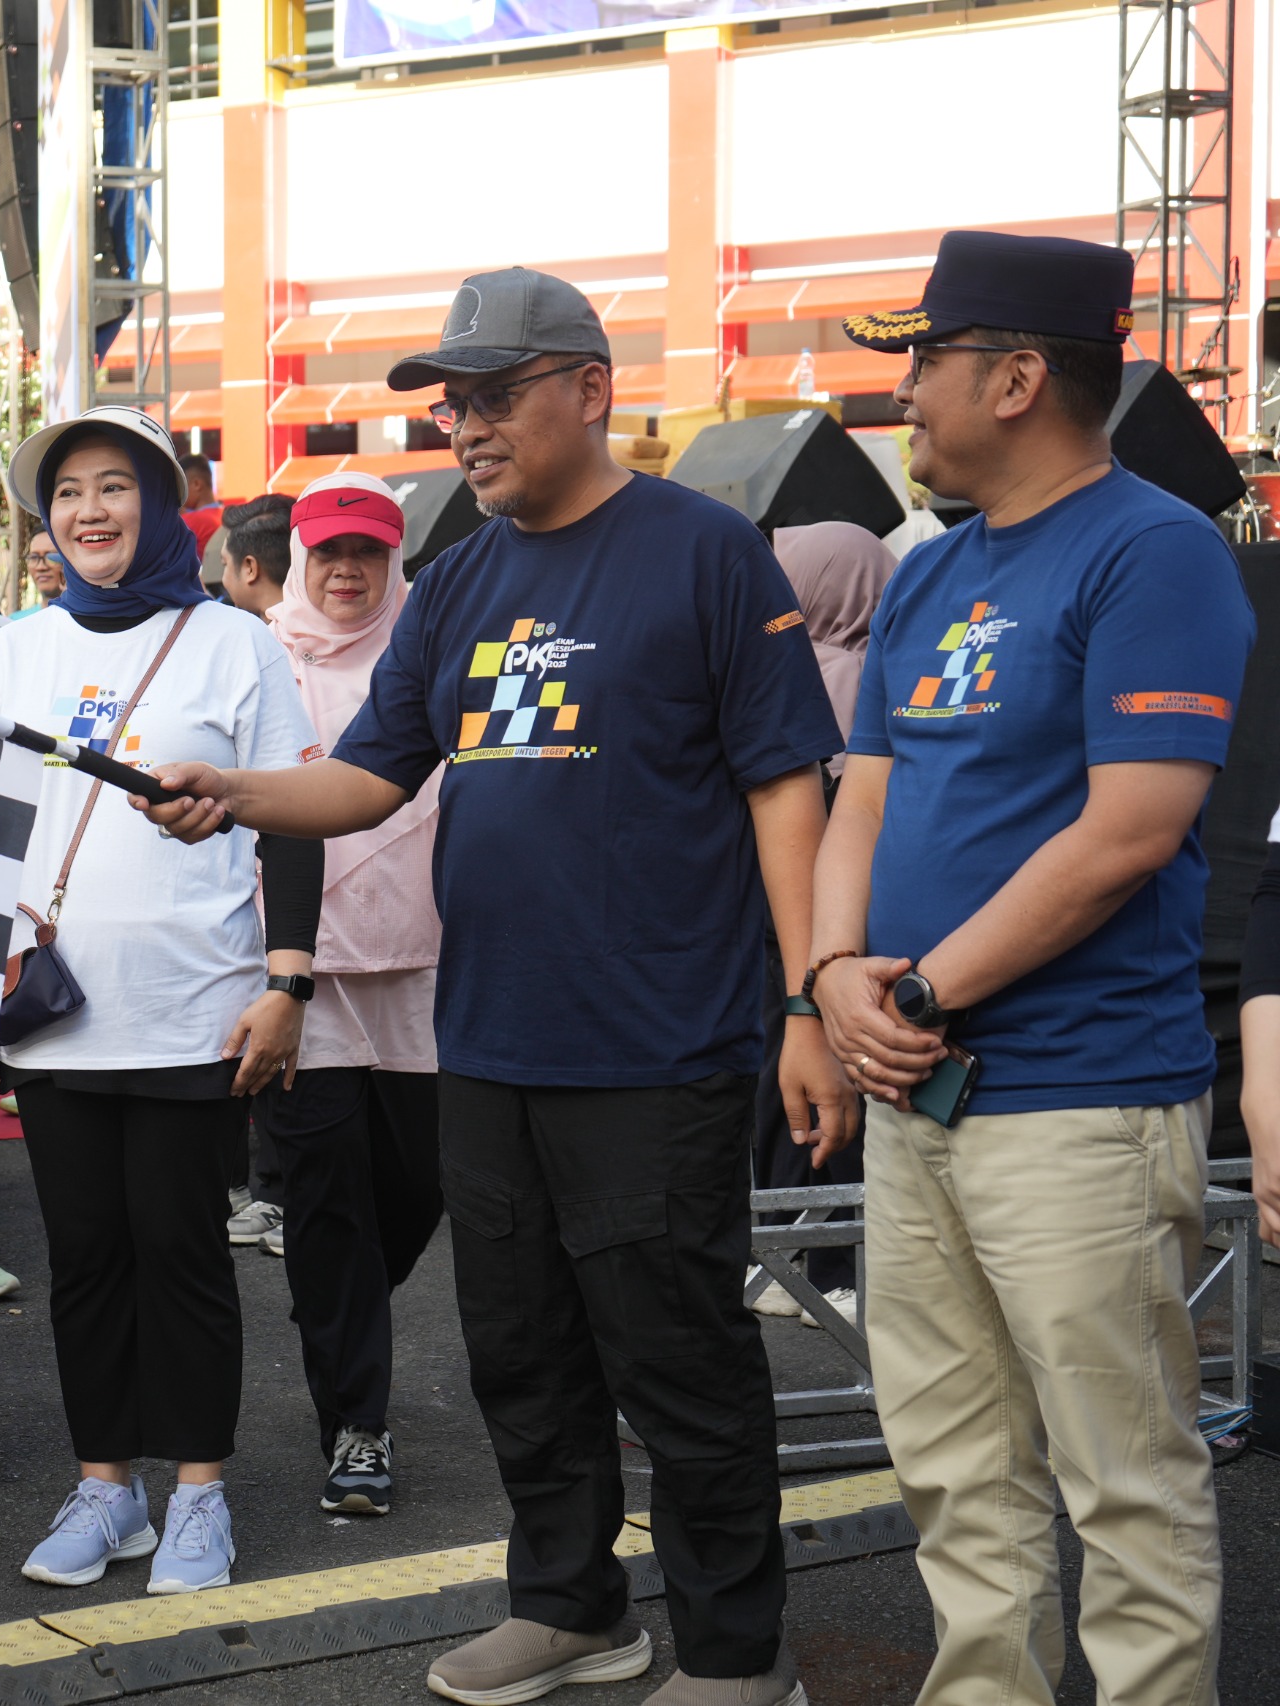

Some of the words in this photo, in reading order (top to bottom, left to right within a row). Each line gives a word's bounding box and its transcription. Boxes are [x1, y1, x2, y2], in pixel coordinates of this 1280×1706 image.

[548, 660, 567, 668] 2025
[79, 700, 118, 723] PKJ
[473, 748, 514, 758] TRANSPORTASI
[514, 747, 539, 757] UNTUK
[541, 747, 567, 756] NEGERI
